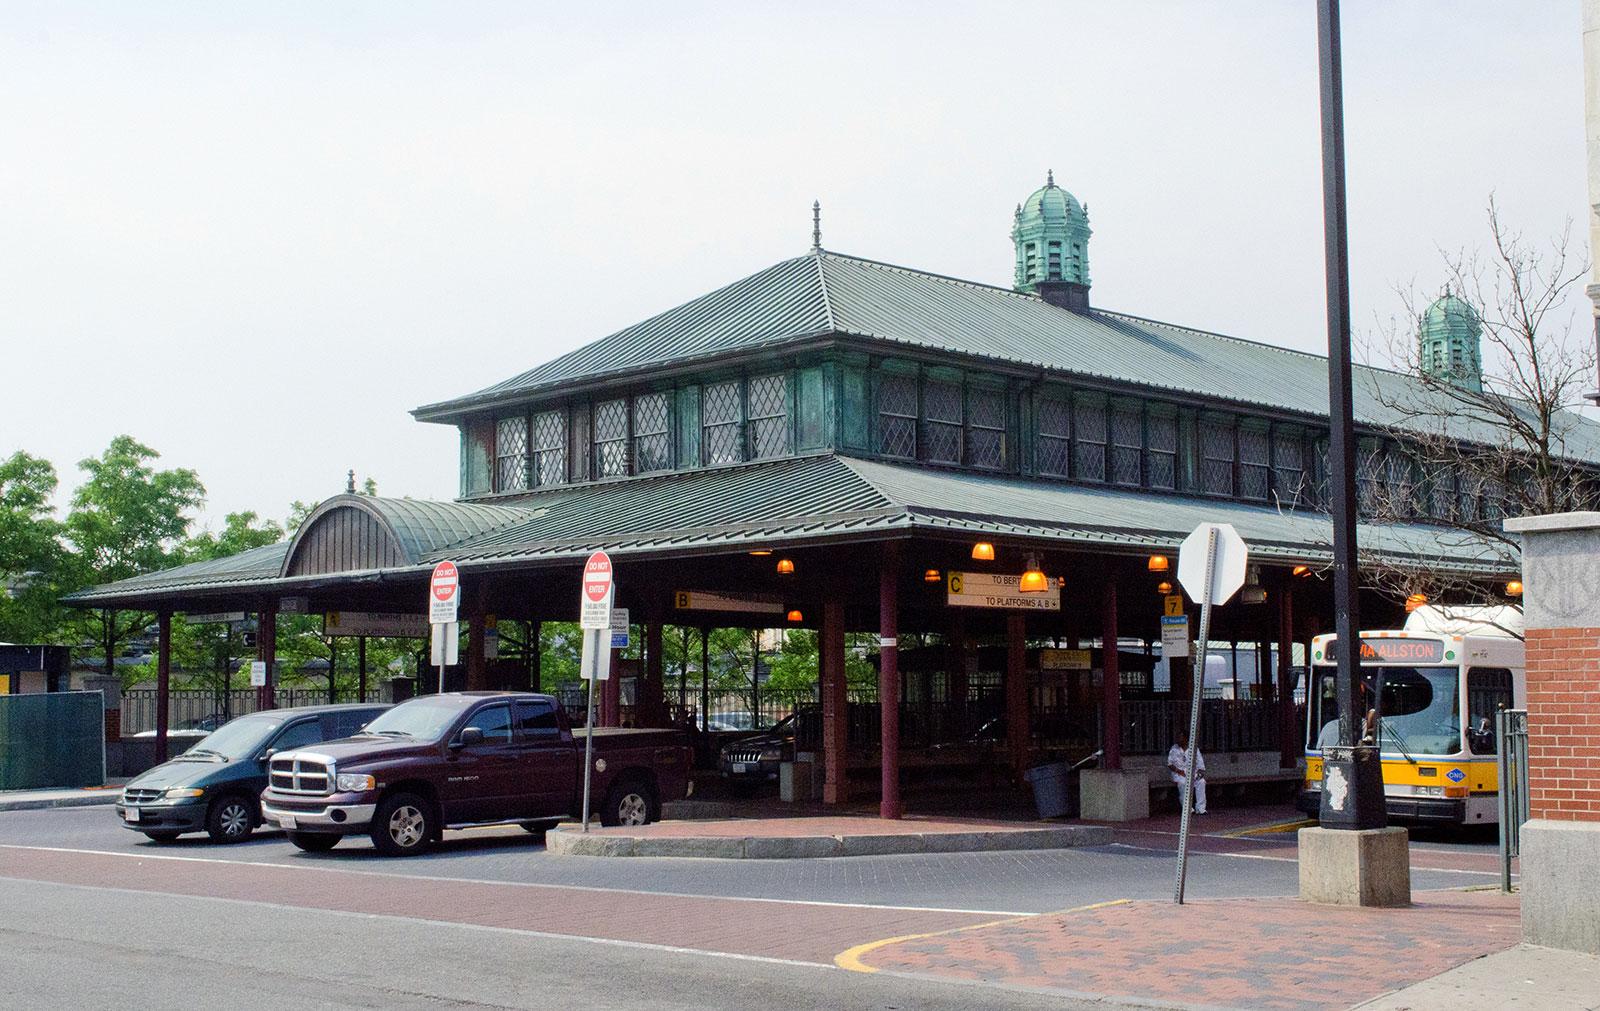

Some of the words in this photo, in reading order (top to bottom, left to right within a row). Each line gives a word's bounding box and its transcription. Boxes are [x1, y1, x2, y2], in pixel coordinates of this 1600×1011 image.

[588, 562, 597, 570] DO
[598, 562, 608, 570] NOT
[445, 568, 454, 576] NOT
[950, 576, 961, 593] C
[991, 575, 1002, 585] TO
[436, 587, 453, 595] ENTER
[588, 585, 605, 593] ENTER
[679, 593, 688, 607] B
[985, 596, 996, 606] TO
[996, 597, 1036, 607] PLATFORMS
[1170, 601, 1177, 613] 7
[1378, 643, 1434, 658] ALLSTON
[1448, 770, 1464, 780] CNG
